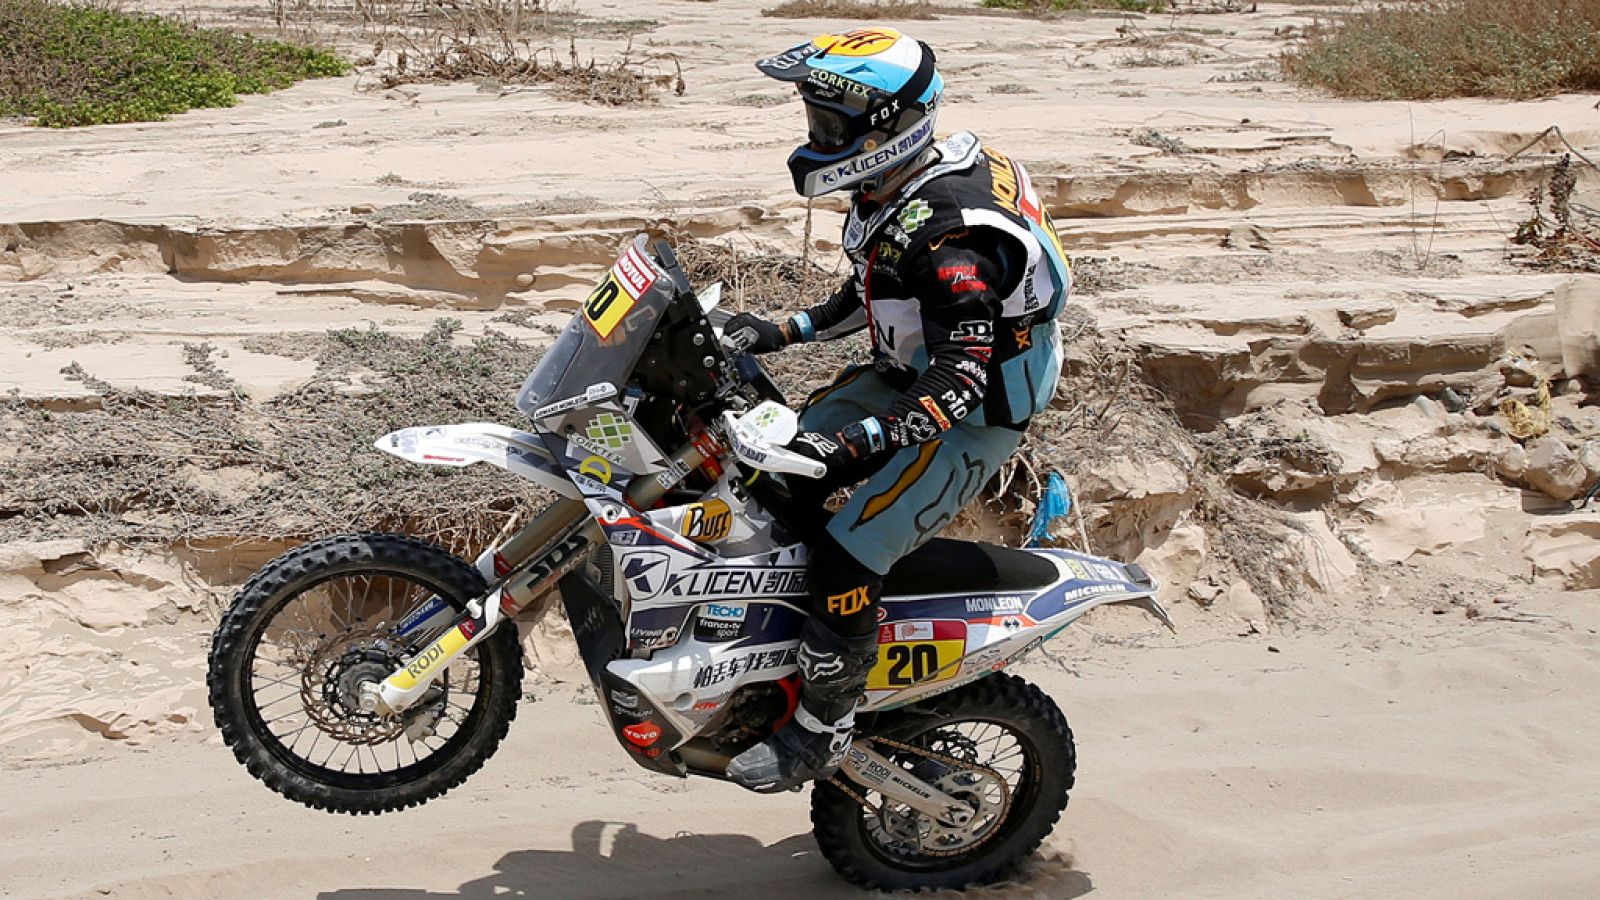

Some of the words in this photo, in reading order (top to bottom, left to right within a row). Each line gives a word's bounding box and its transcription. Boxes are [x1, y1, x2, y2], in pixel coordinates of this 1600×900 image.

[810, 69, 870, 97] CORKTEX
[869, 99, 900, 126] FOX
[827, 586, 871, 616] FOX
[965, 596, 1023, 612] MONLEON
[1064, 583, 1126, 601] MICHELIN
[716, 628, 740, 639] sport
[407, 643, 445, 679] RODI
[887, 644, 939, 686] 20
